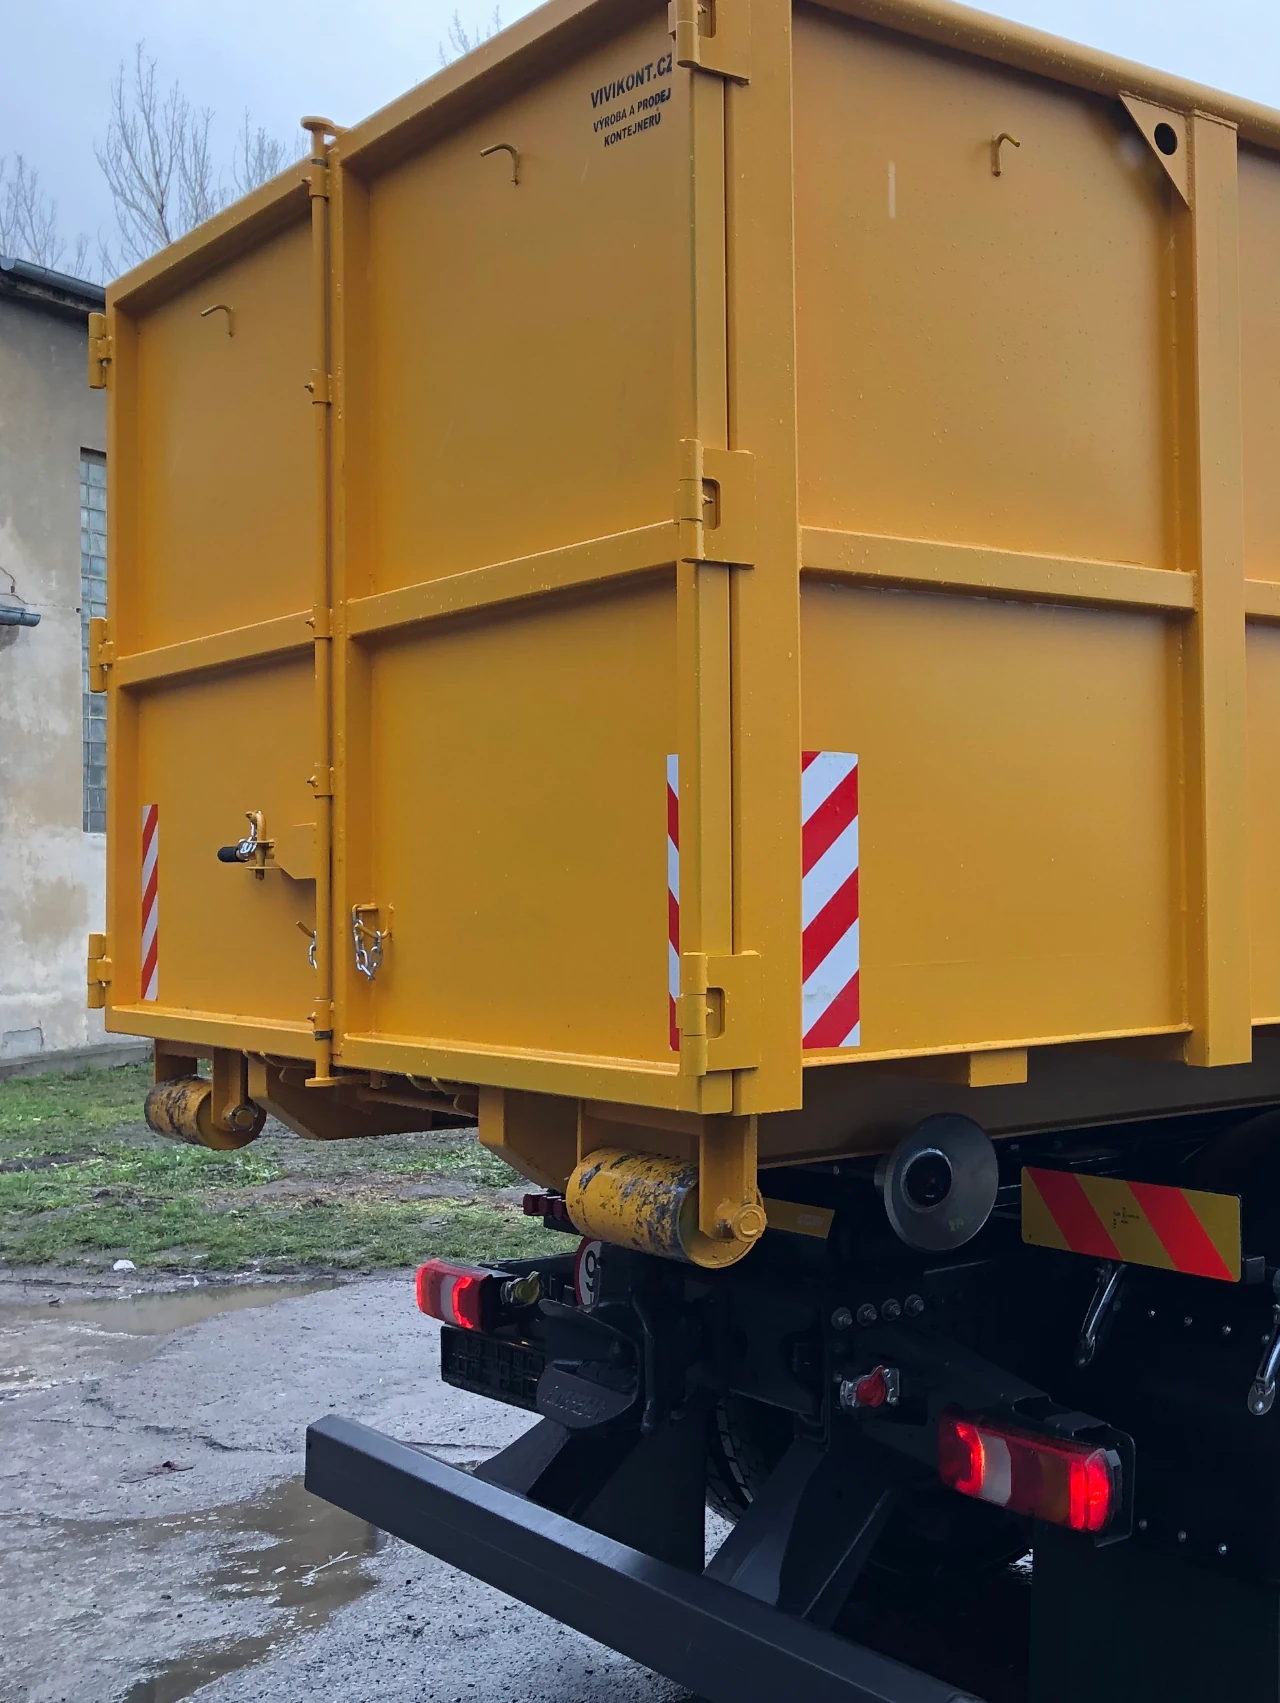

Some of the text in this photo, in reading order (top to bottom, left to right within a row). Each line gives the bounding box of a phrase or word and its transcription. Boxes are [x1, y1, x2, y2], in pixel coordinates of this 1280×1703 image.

[591, 52, 673, 108] VIVIKONT.CZ
[593, 87, 672, 133] VÝROBA A PRODEJ
